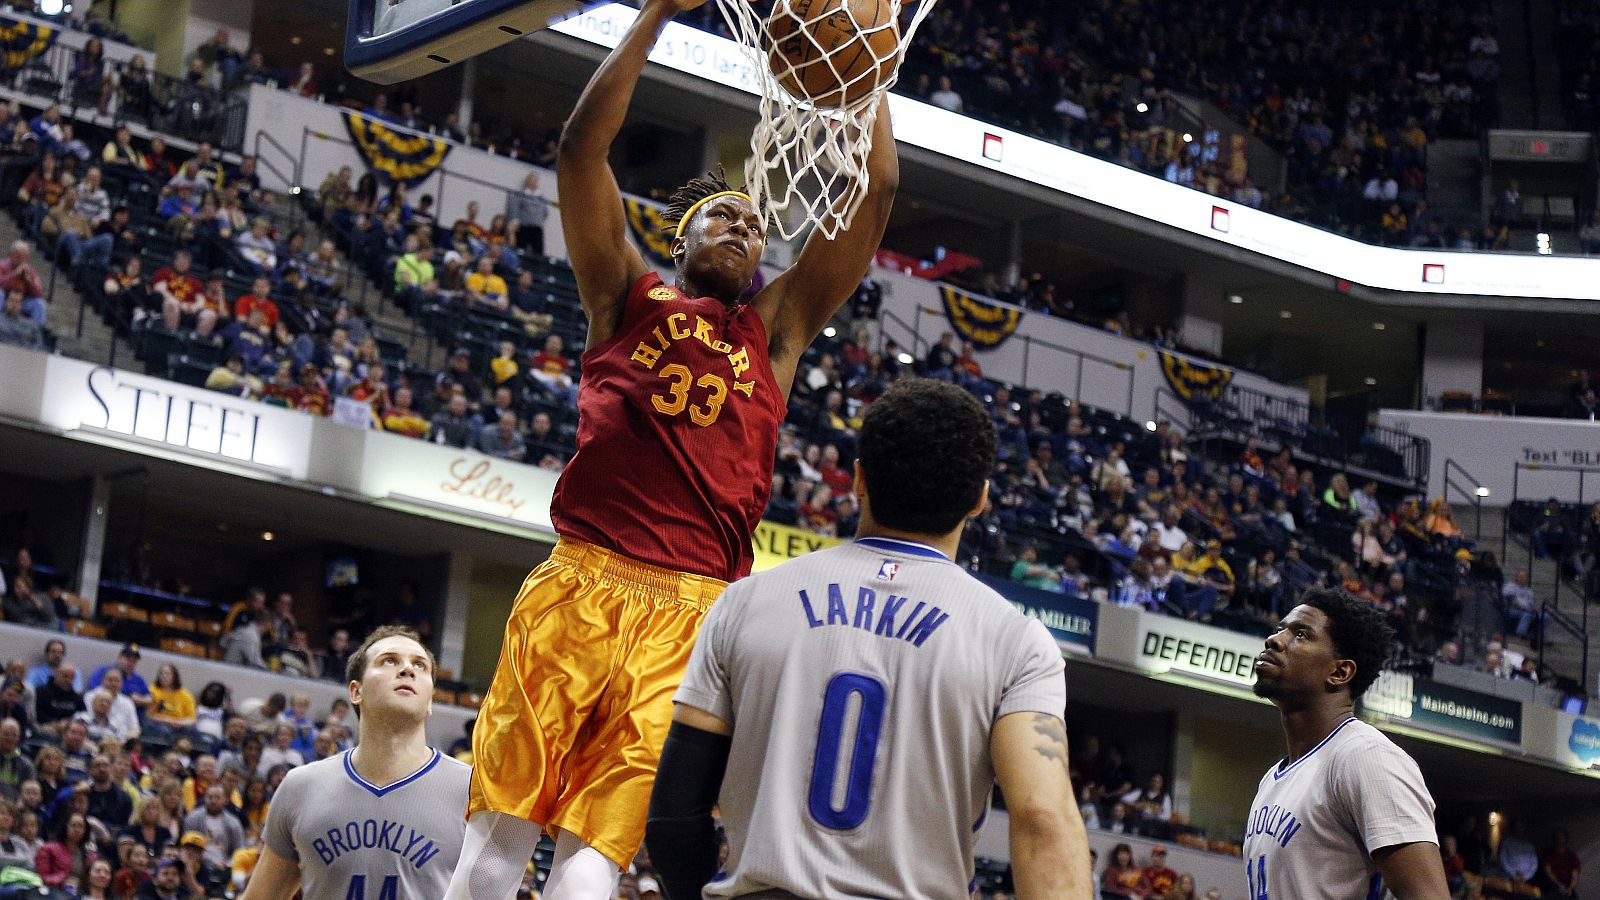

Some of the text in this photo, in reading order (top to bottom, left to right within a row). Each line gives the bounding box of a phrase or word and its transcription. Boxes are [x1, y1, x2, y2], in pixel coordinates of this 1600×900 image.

[684, 41, 706, 65] 10
[630, 313, 756, 397] HICKORY
[651, 363, 728, 427] 33
[1522, 447, 1557, 463] Text
[440, 456, 526, 518] Lilly
[752, 527, 822, 557] NLEY
[798, 583, 950, 648] LARKIN
[808, 672, 887, 830] 0
[312, 819, 440, 869] BROOKLYN
